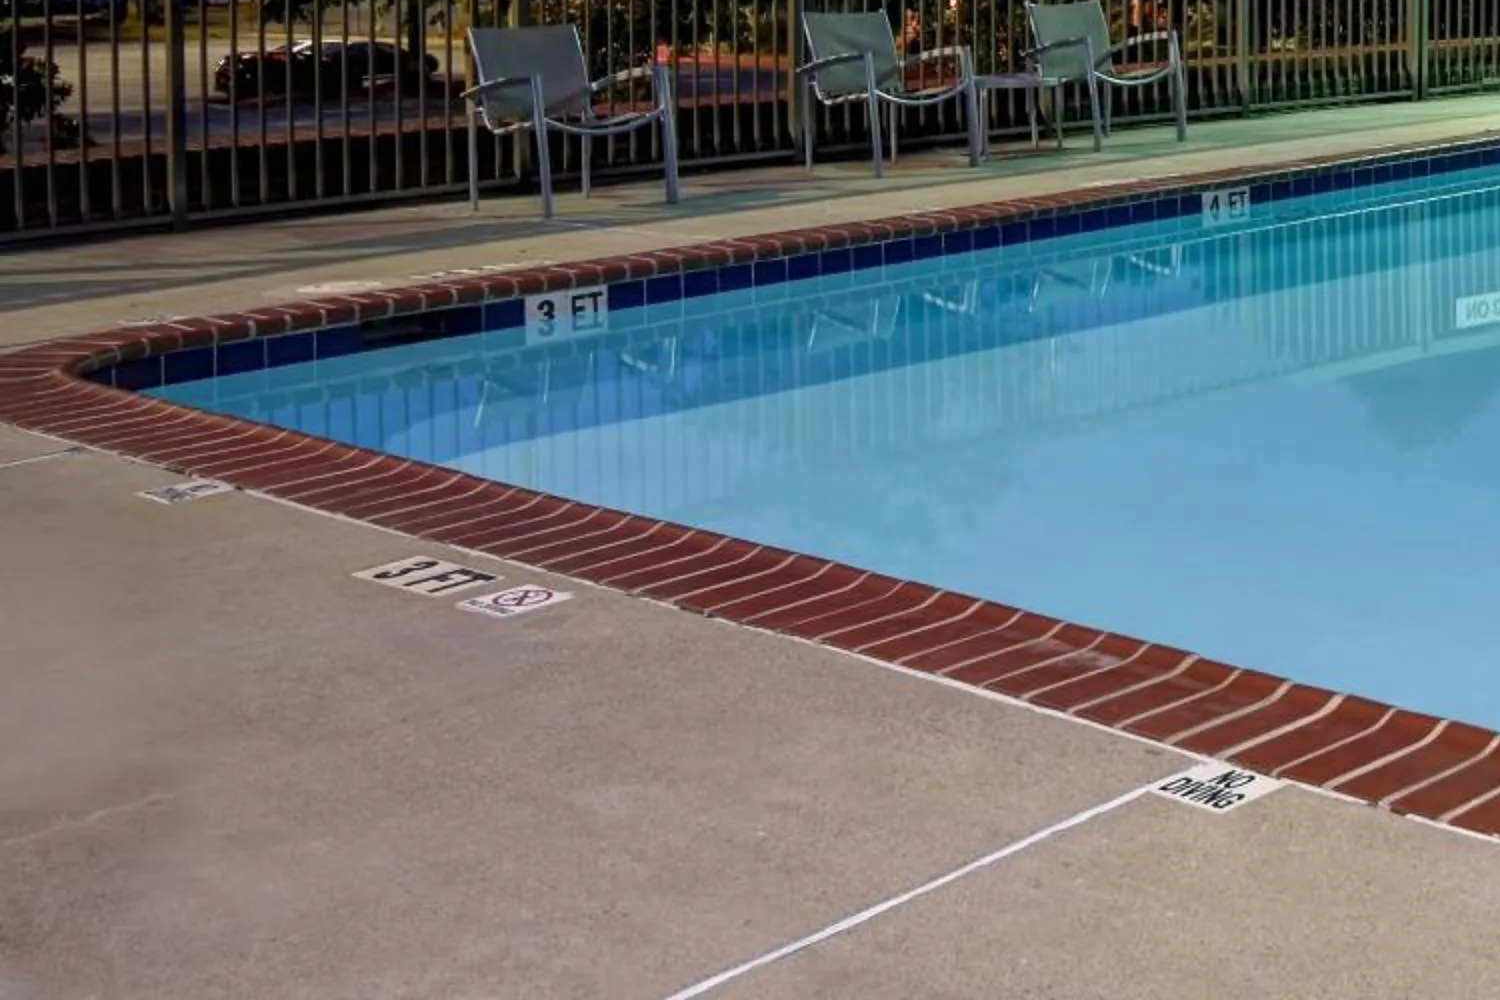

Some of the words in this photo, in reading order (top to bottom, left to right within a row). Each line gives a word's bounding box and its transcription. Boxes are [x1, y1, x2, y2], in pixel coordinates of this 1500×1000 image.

[537, 300, 555, 325] 3
[572, 291, 602, 319] FT
[372, 561, 440, 579] 3
[402, 567, 498, 593] FT
[1208, 769, 1256, 789] NO
[1158, 777, 1246, 809] DIVING
